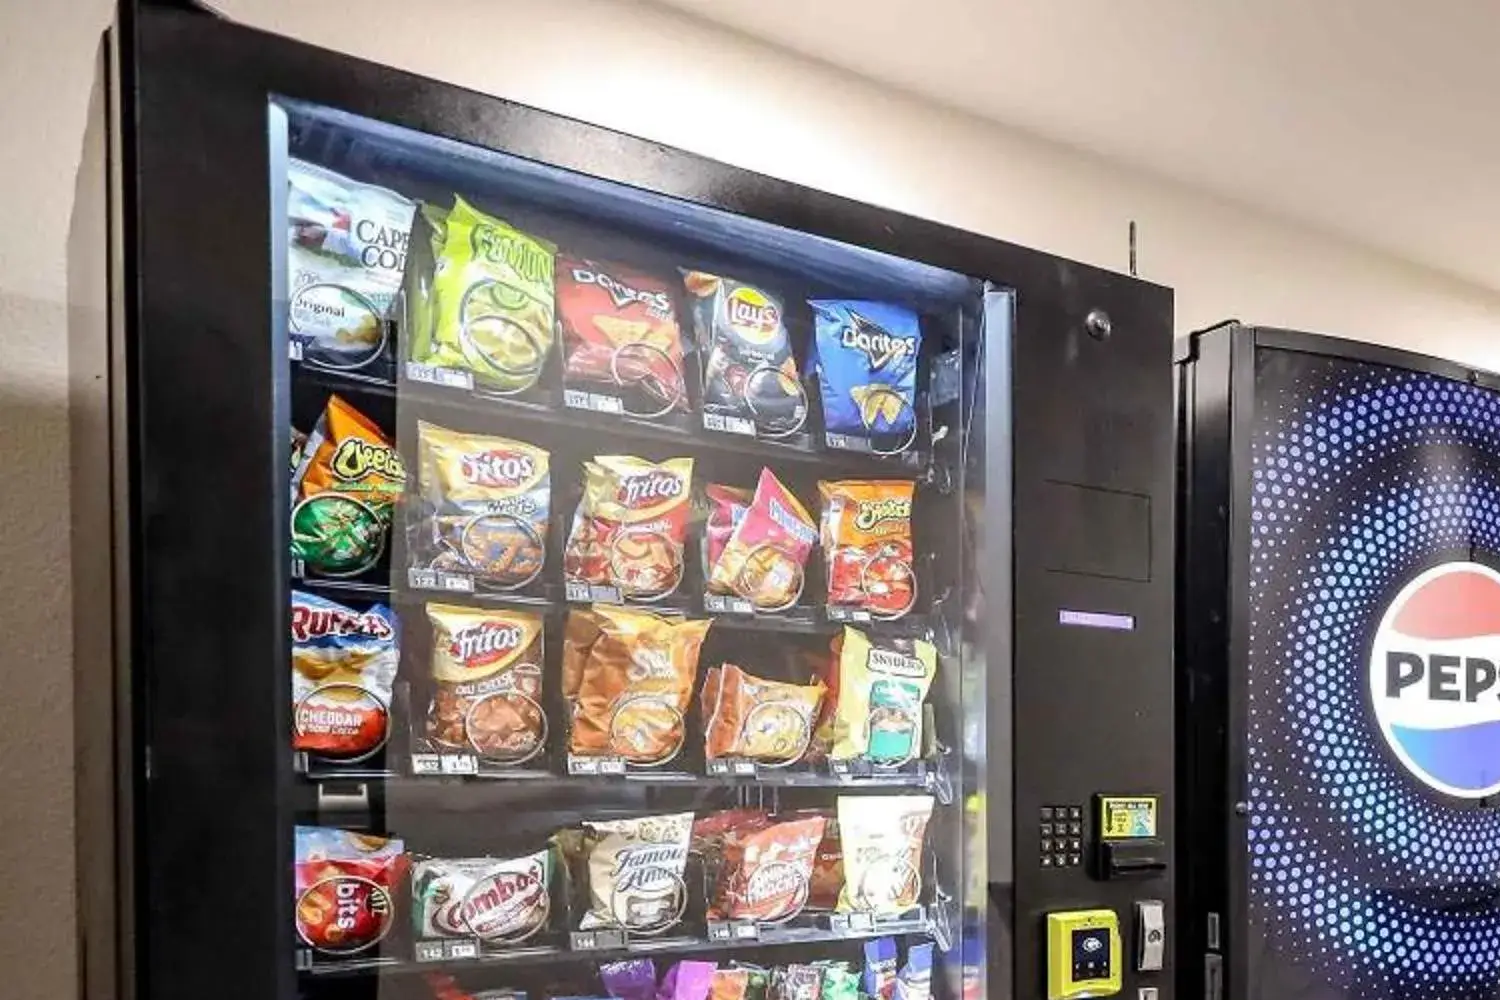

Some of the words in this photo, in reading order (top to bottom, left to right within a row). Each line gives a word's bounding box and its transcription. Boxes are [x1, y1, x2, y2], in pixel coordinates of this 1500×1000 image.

[451, 624, 523, 663] Fritos
[335, 882, 360, 929] bits
[447, 865, 541, 929] Combos
